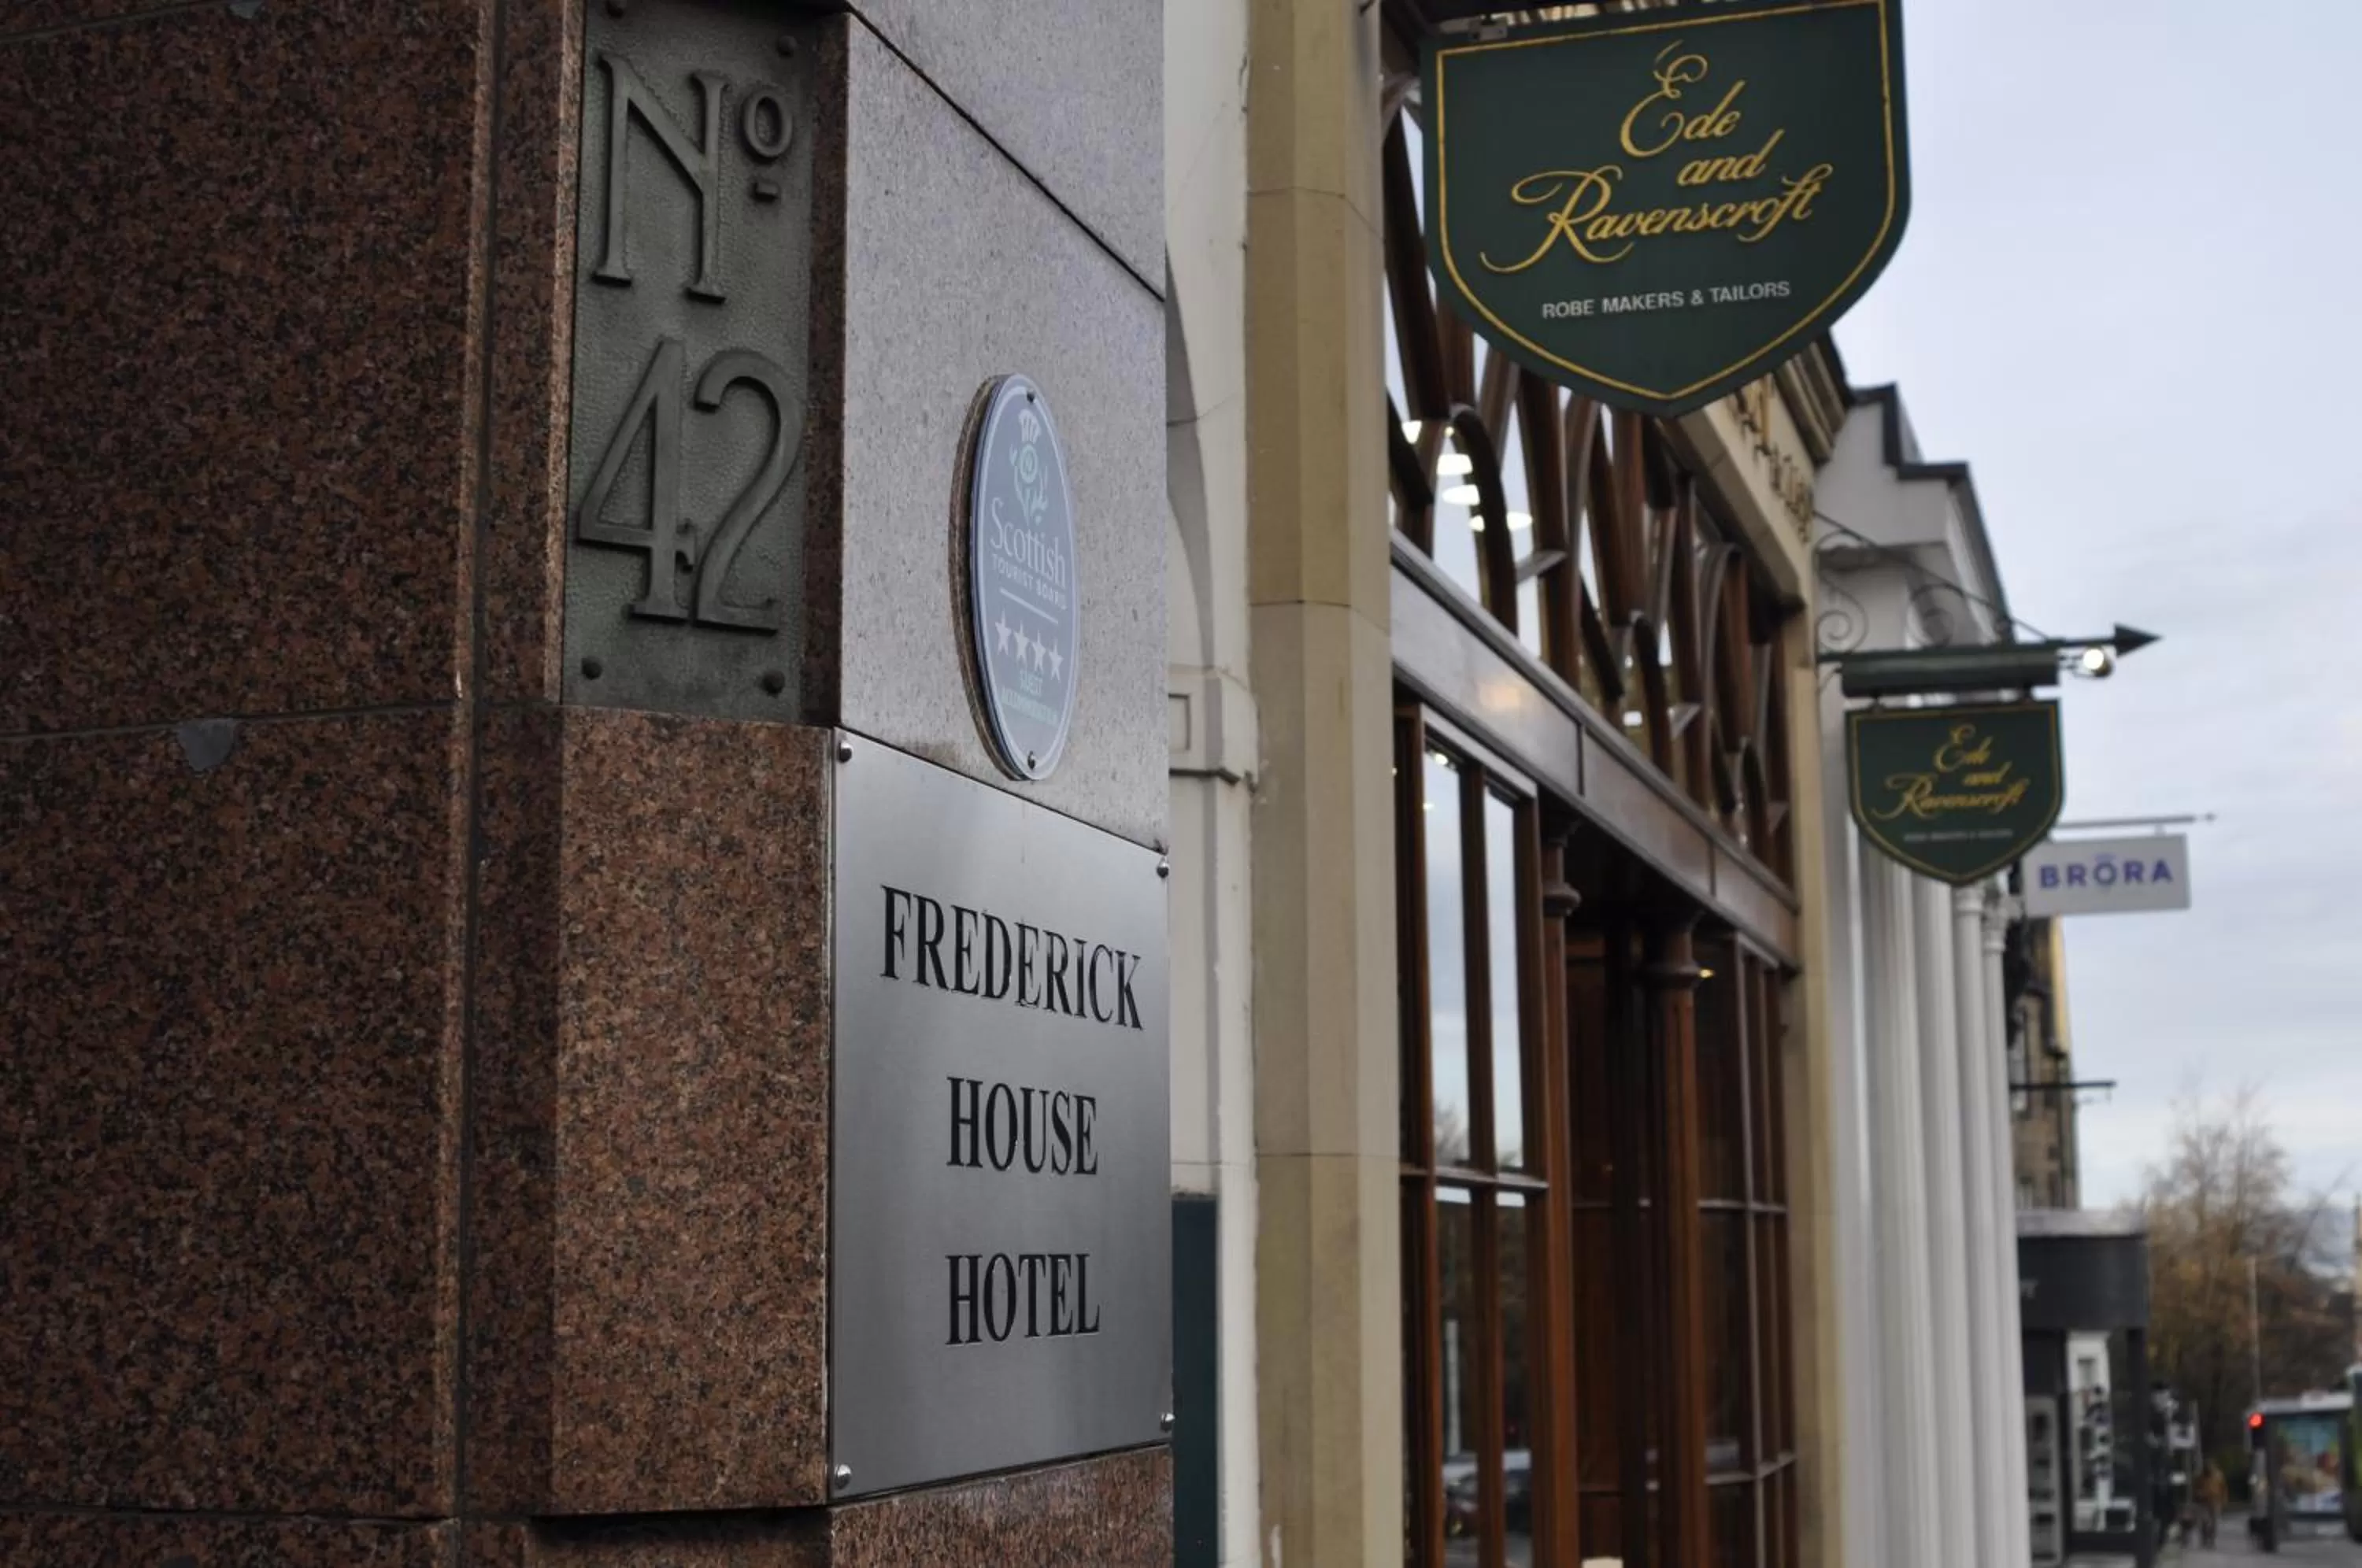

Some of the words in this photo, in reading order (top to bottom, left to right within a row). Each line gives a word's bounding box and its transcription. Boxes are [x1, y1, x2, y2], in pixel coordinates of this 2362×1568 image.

[1620, 39, 1746, 157] Ede
[1676, 128, 1785, 187] and
[1480, 164, 1834, 272] Ravenscroft
[1542, 298, 1594, 319] ROBE
[1601, 290, 1685, 312] MAKERS
[1690, 289, 1705, 305] &
[1708, 280, 1790, 303] TAILORS
[576, 336, 803, 637] 42
[990, 497, 1066, 589] Scottish
[879, 884, 1145, 1030] FREDERICK
[946, 1077, 1099, 1176] HOUSE
[945, 1252, 1101, 1345] HOTEL
